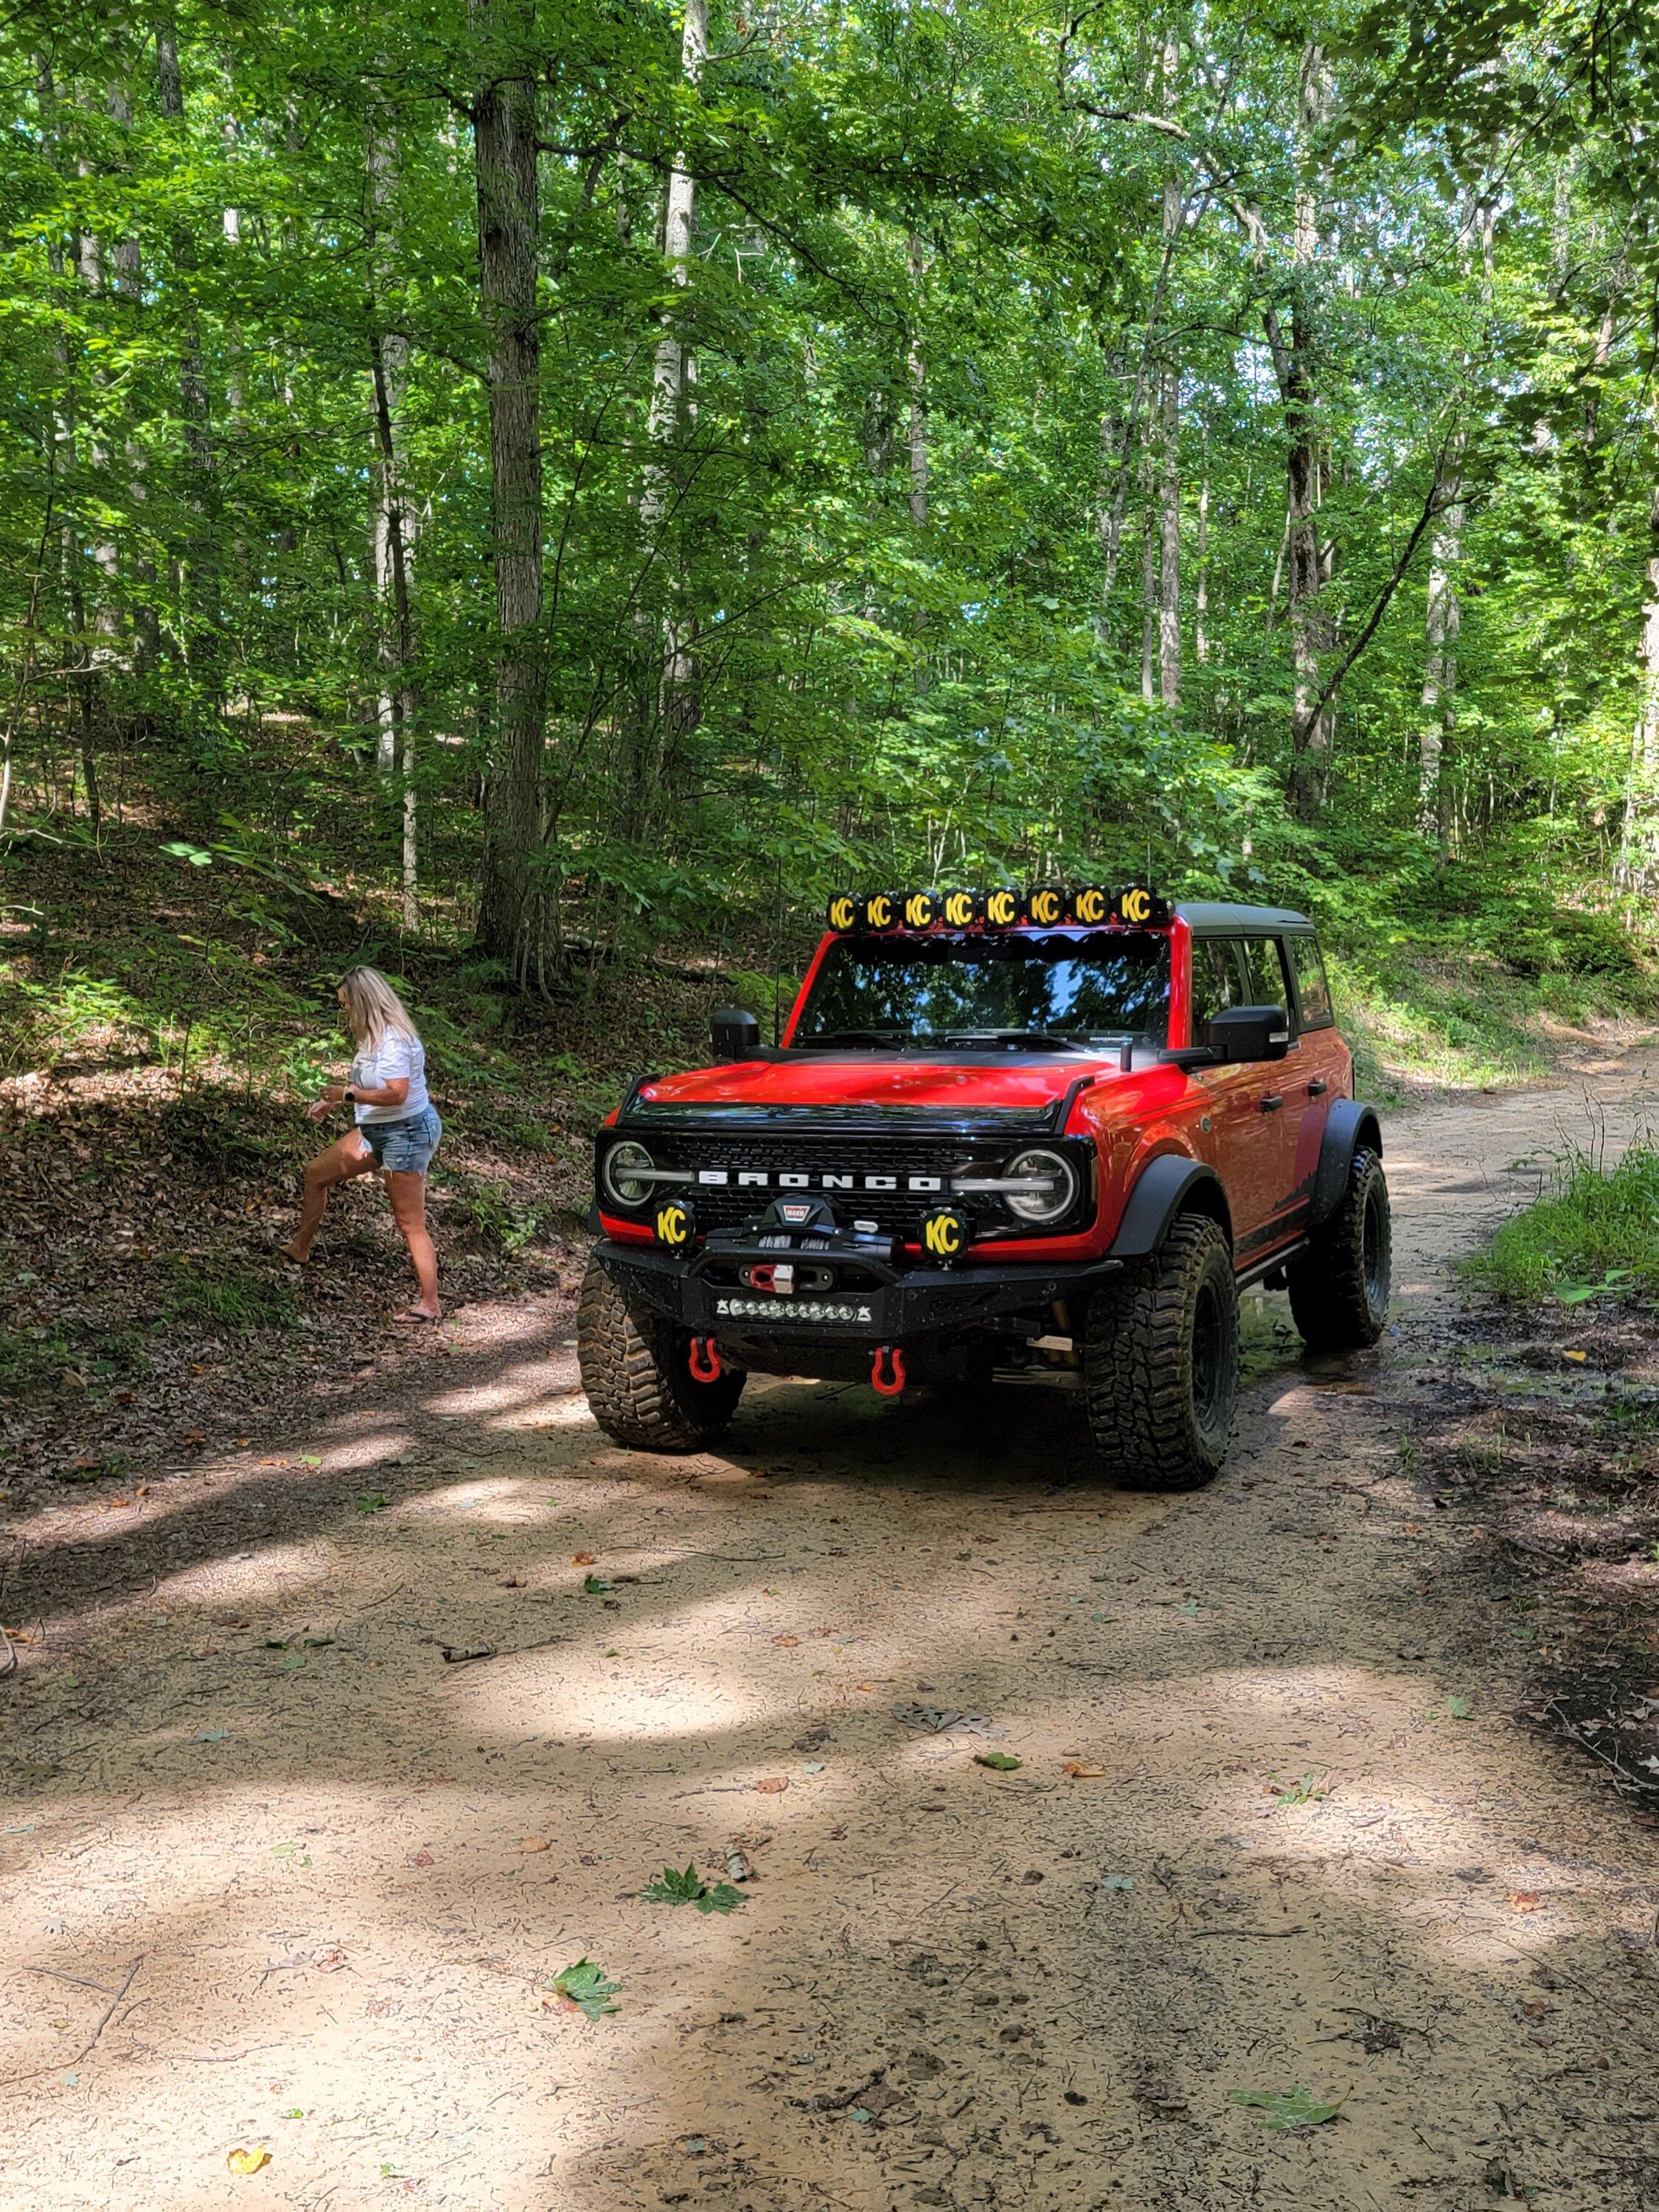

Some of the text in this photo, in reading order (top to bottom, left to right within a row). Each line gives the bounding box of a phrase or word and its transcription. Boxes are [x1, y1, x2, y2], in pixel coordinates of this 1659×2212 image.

[830, 897, 854, 929] KC
[867, 896, 891, 926] KC
[905, 894, 931, 927] KC
[945, 892, 973, 925] KC
[987, 891, 1015, 925] KC
[1031, 890, 1059, 923] KC
[1076, 889, 1105, 922] KC
[1121, 888, 1150, 922] KC
[698, 1170, 942, 1191] BRONCO
[658, 1206, 686, 1245] KC
[926, 1214, 959, 1254] KC
